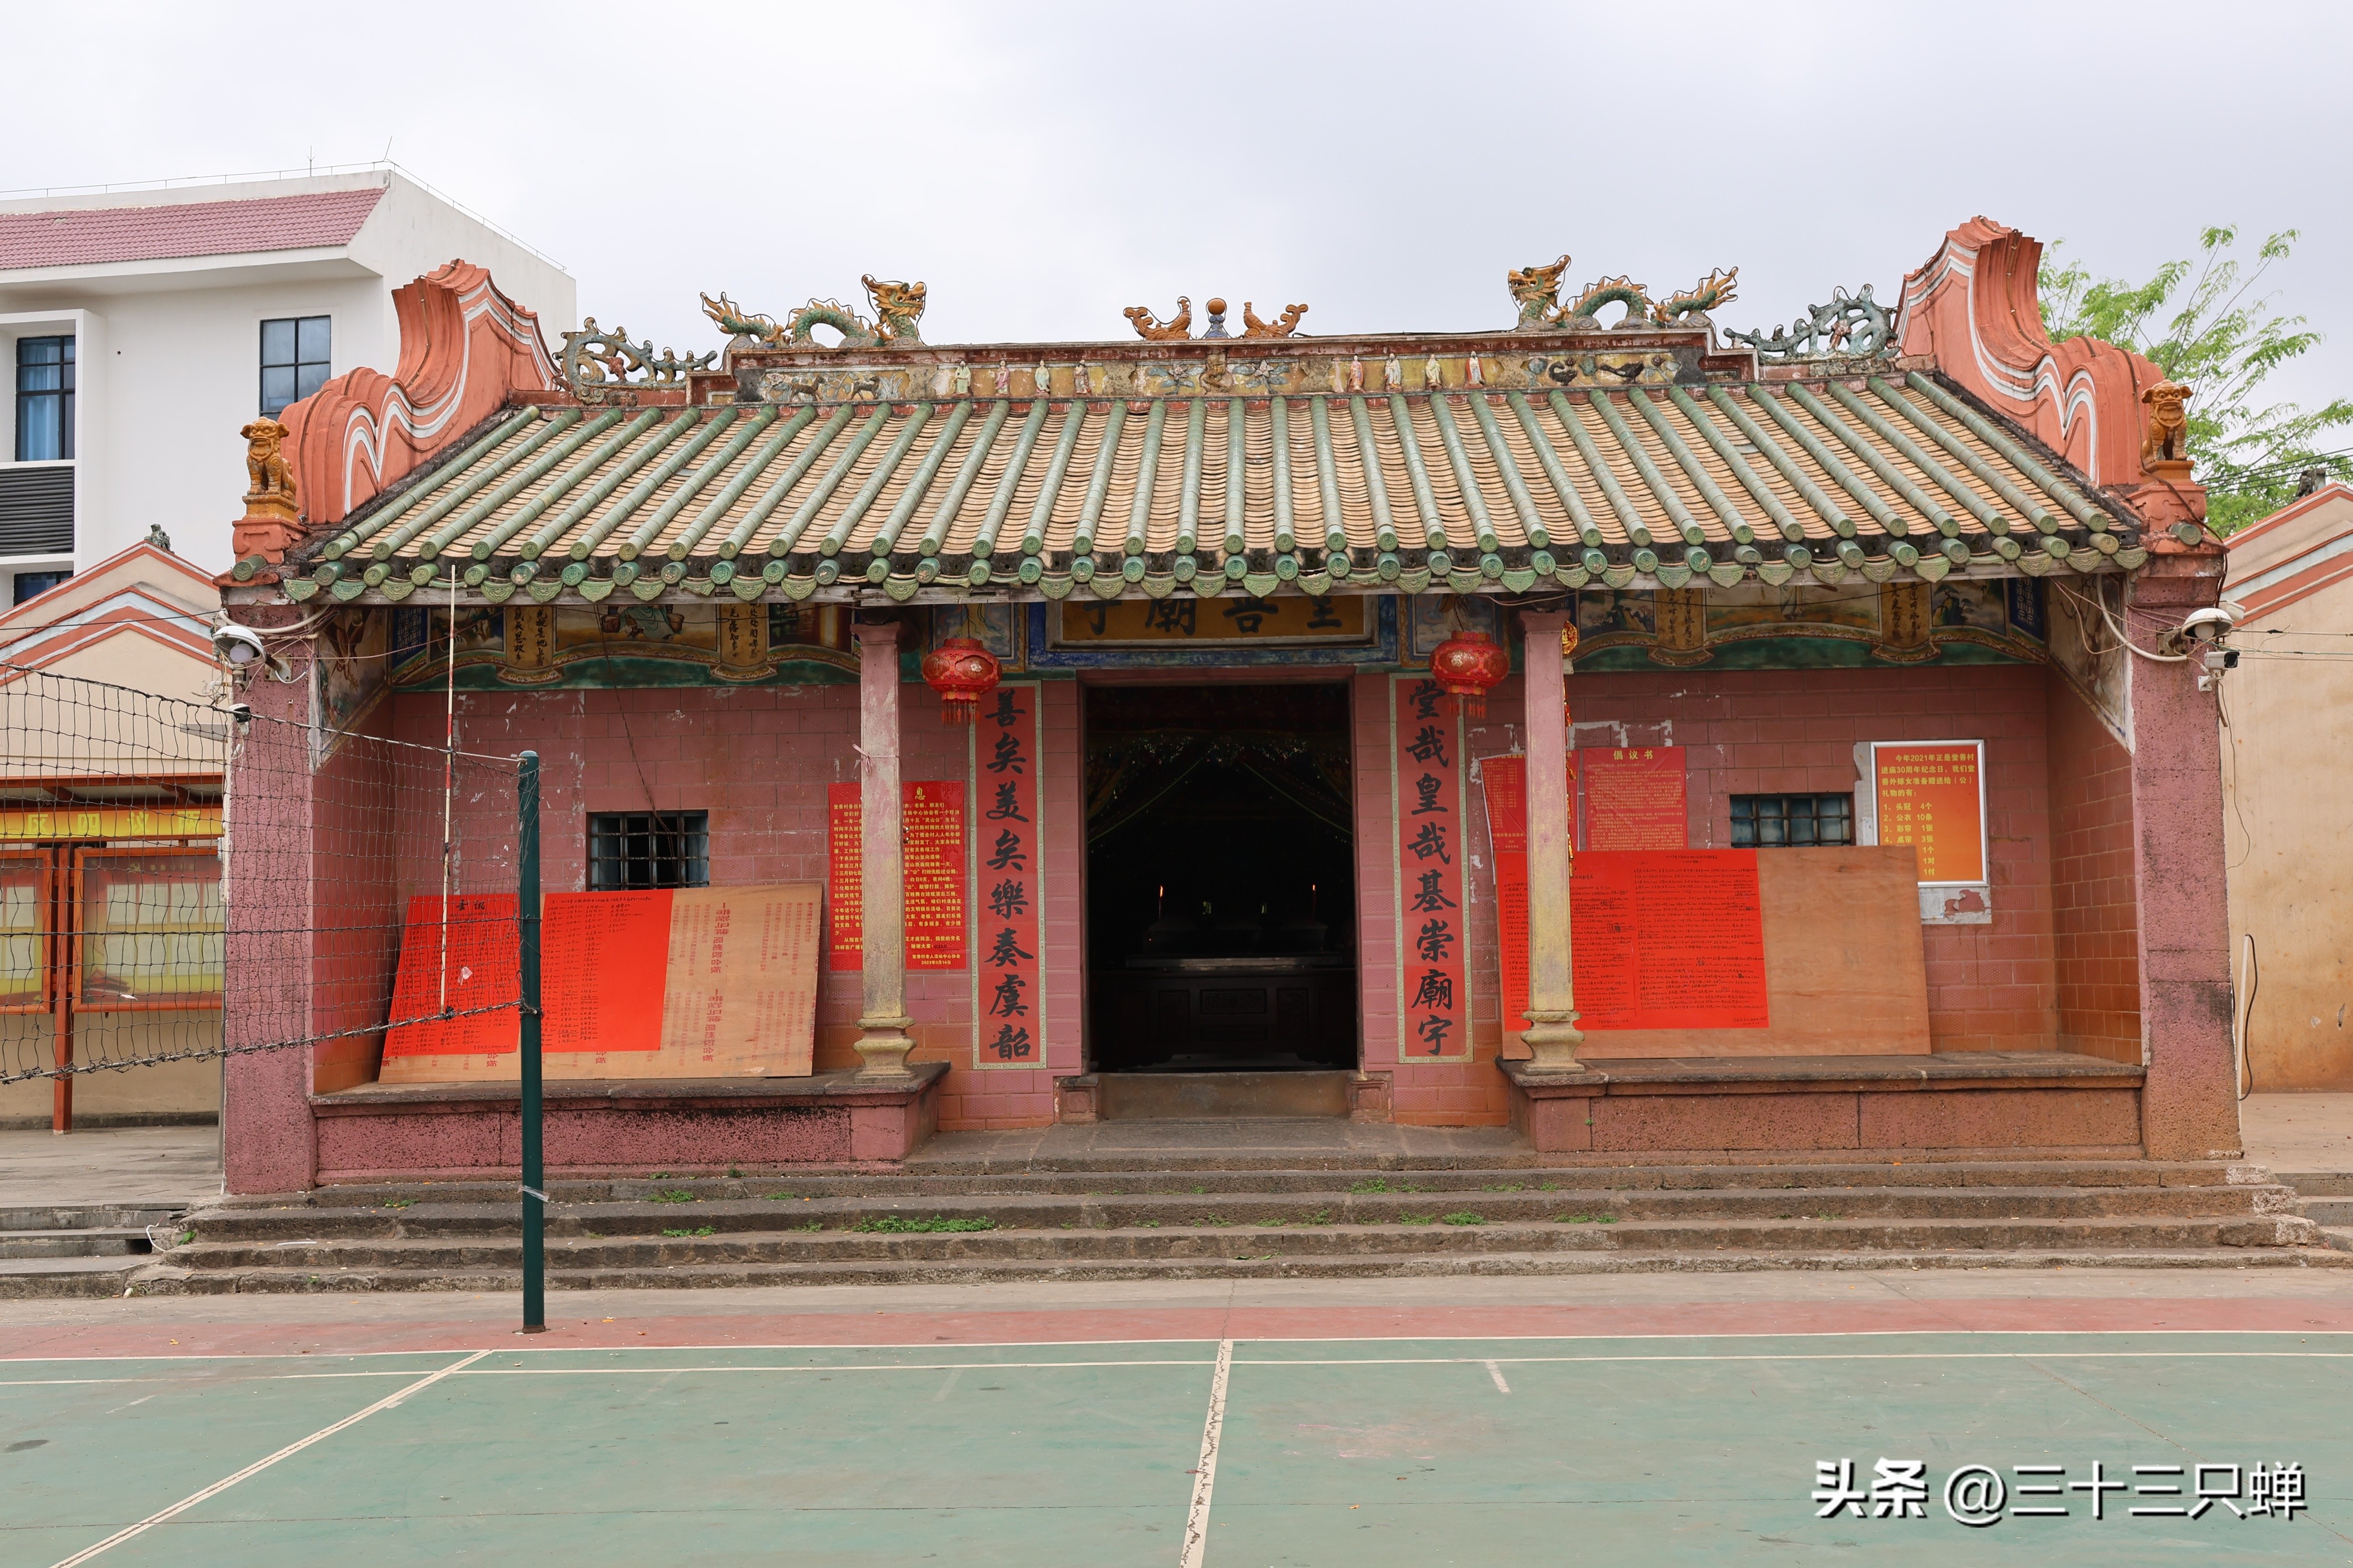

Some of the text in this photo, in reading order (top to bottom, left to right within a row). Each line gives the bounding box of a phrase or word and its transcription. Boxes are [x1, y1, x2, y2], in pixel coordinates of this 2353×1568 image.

[1614, 750, 1653, 760] 倡议书
[1895, 753, 1974, 762] 今年2021年正是堂善村
[984, 689, 1034, 1061] 善矣美矣樂奏虞韶
[1405, 679, 1457, 1056] 堂哉皇哉基崇廟宇
